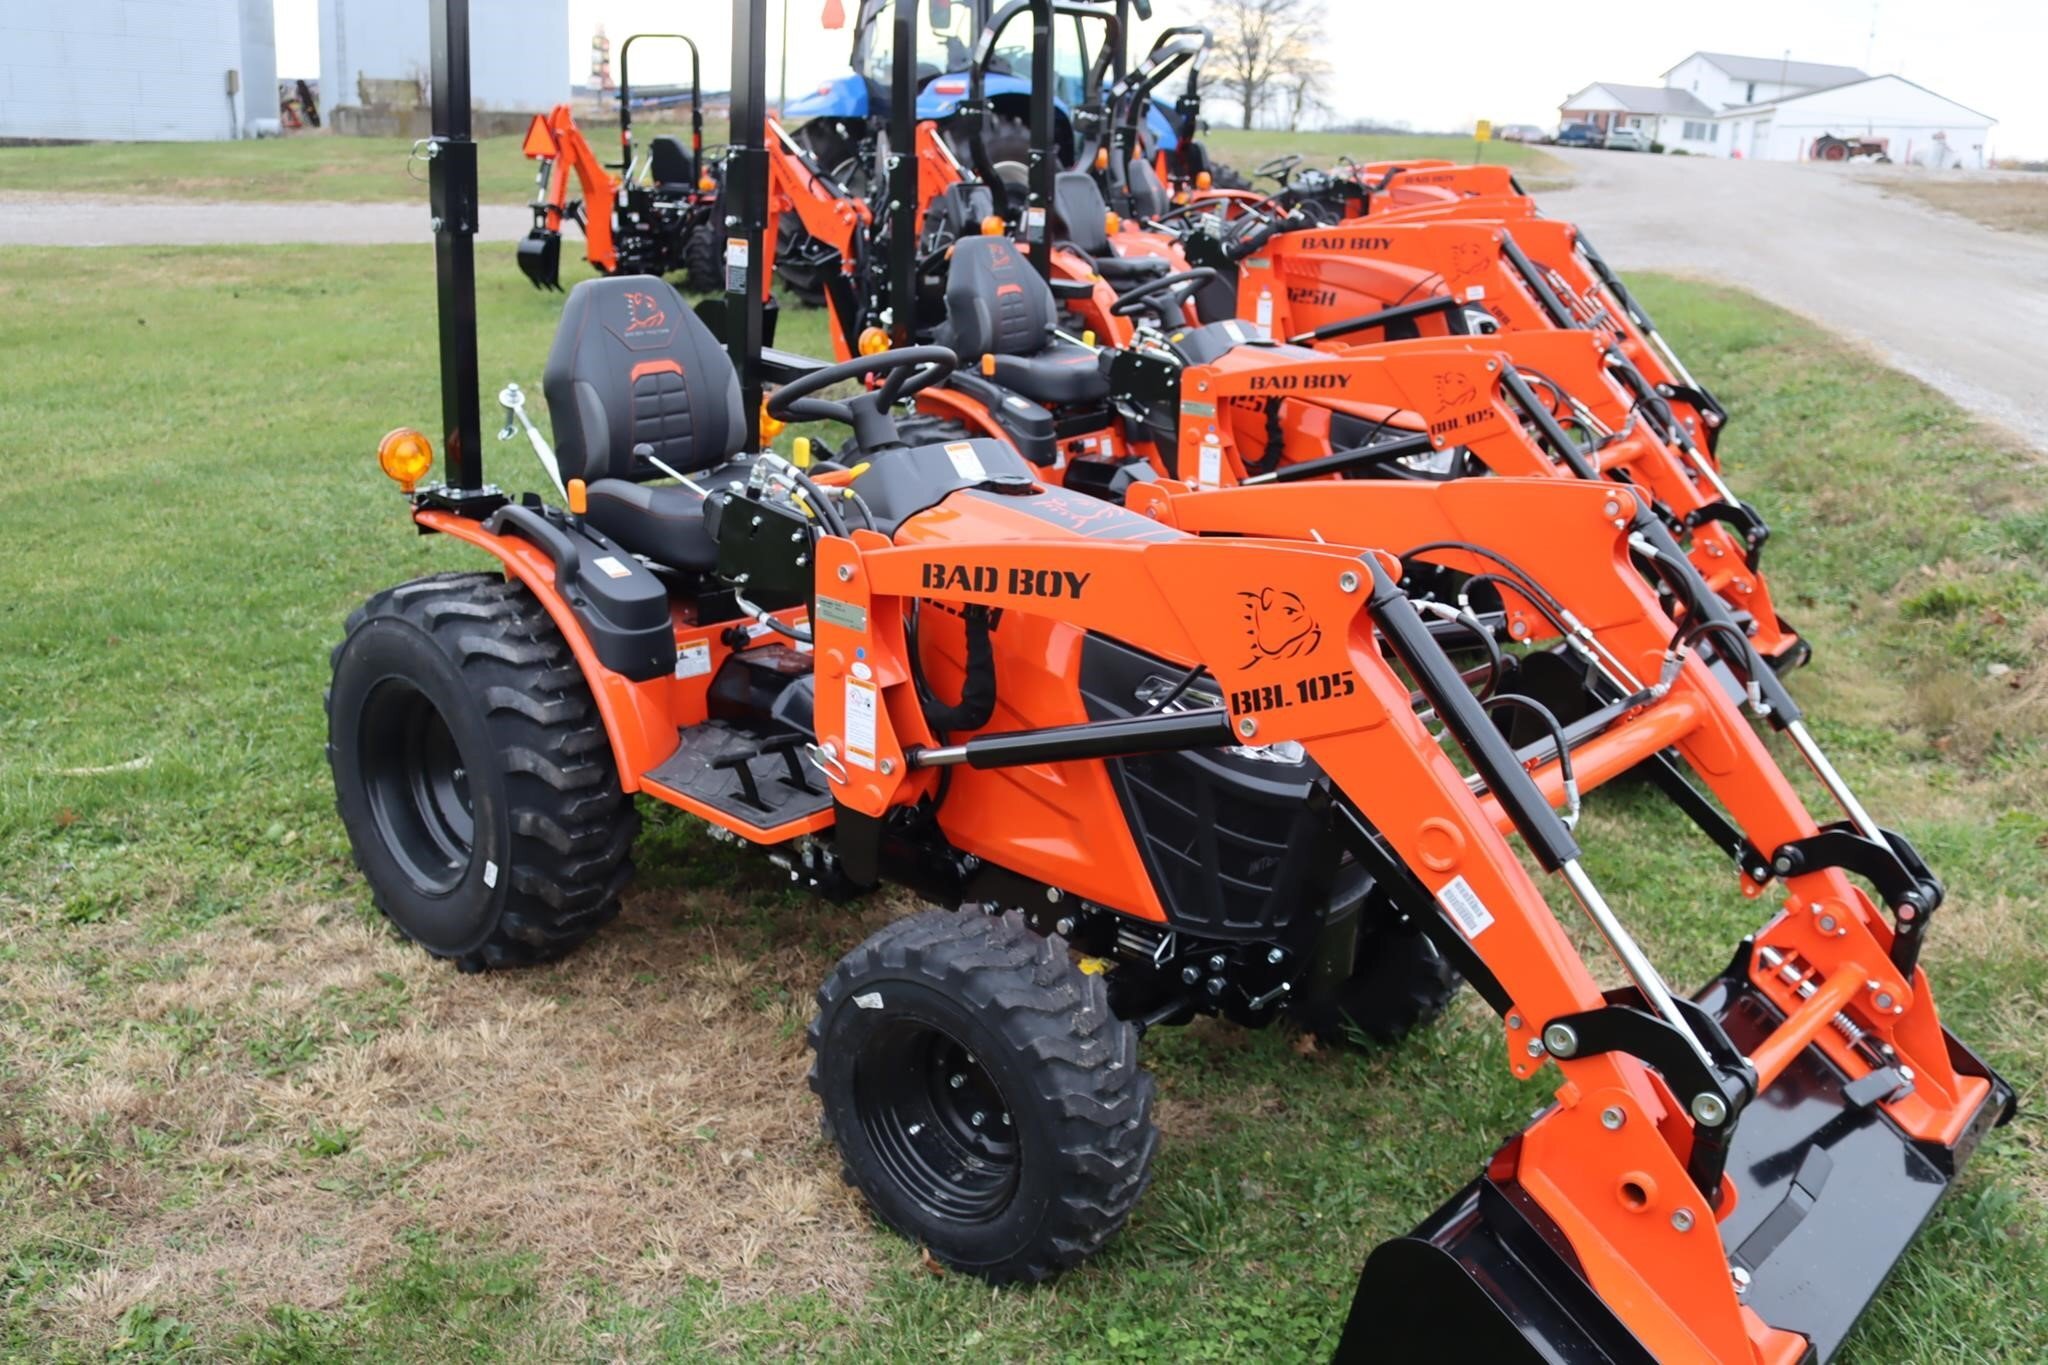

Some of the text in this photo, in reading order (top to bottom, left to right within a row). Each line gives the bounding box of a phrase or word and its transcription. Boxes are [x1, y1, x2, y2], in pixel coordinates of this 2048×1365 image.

[1301, 237, 1395, 250] BAD BOY
[1249, 373, 1353, 390] BAD BOY
[1431, 408, 1495, 436] BBL 105
[922, 563, 1091, 600] BAD BOY
[1231, 670, 1355, 716] BBL 105
